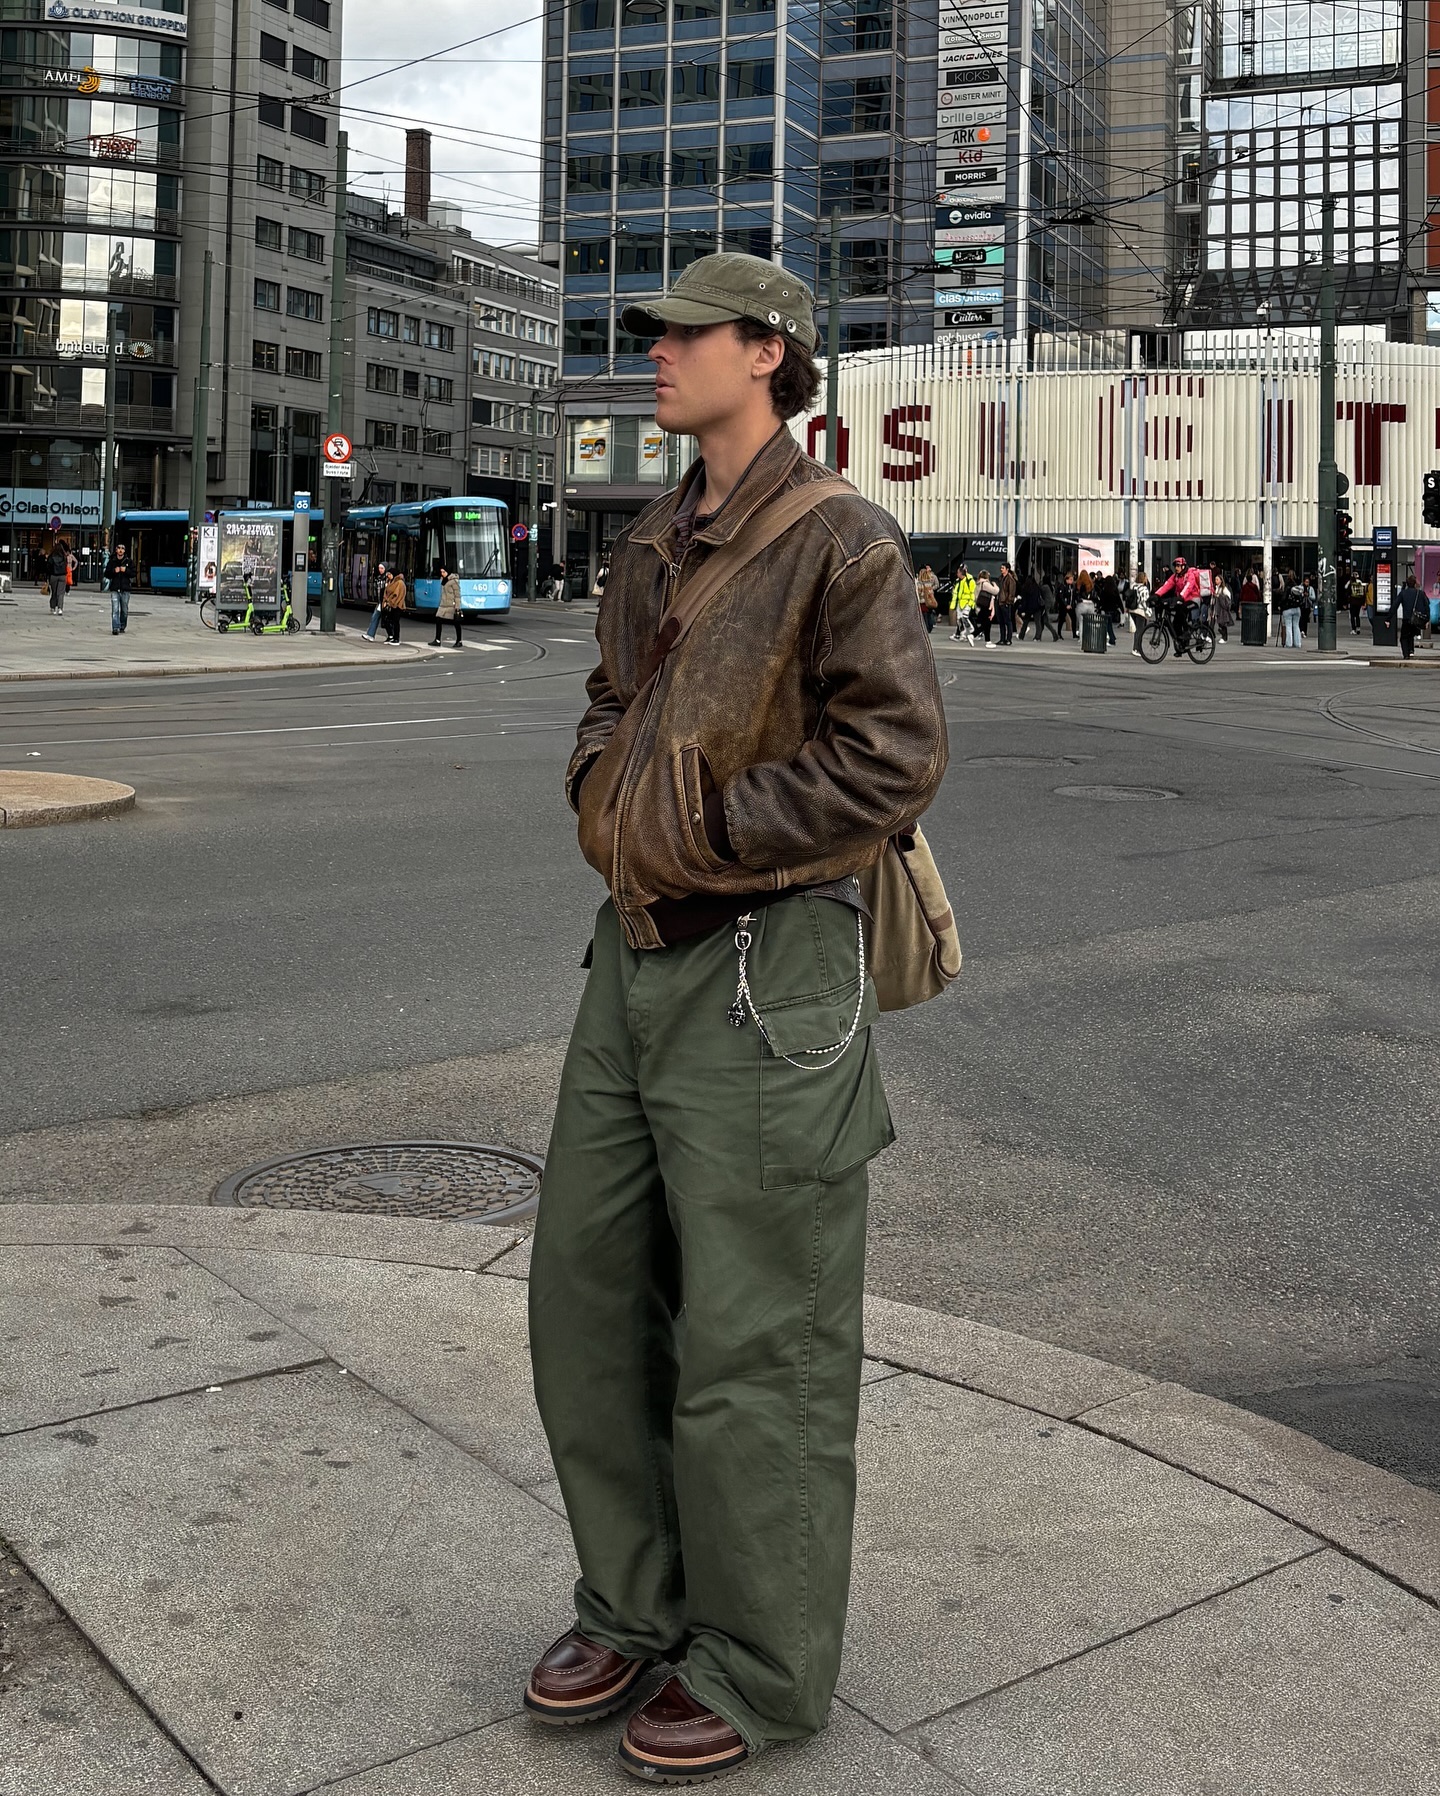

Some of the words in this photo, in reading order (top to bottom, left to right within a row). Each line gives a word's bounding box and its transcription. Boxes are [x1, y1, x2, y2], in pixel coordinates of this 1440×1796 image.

[72, 8, 101, 19] OLAV
[104, 10, 134, 24] THON
[138, 15, 187, 32] GRUPPEN
[942, 11, 1005, 23] VINMONOPOLET
[943, 54, 966, 63] JACK
[974, 51, 1003, 60] JONES
[954, 70, 991, 83] KICKS
[954, 93, 981, 102] MISTER
[941, 109, 1002, 123] brilleland
[952, 129, 975, 144] ARK
[958, 149, 983, 164] Kid
[955, 172, 987, 181] MORRIS
[964, 210, 991, 220] evidia
[16, 501, 47, 514] Clas
[50, 502, 100, 515] Ohlson
[472, 583, 488, 591] 460
